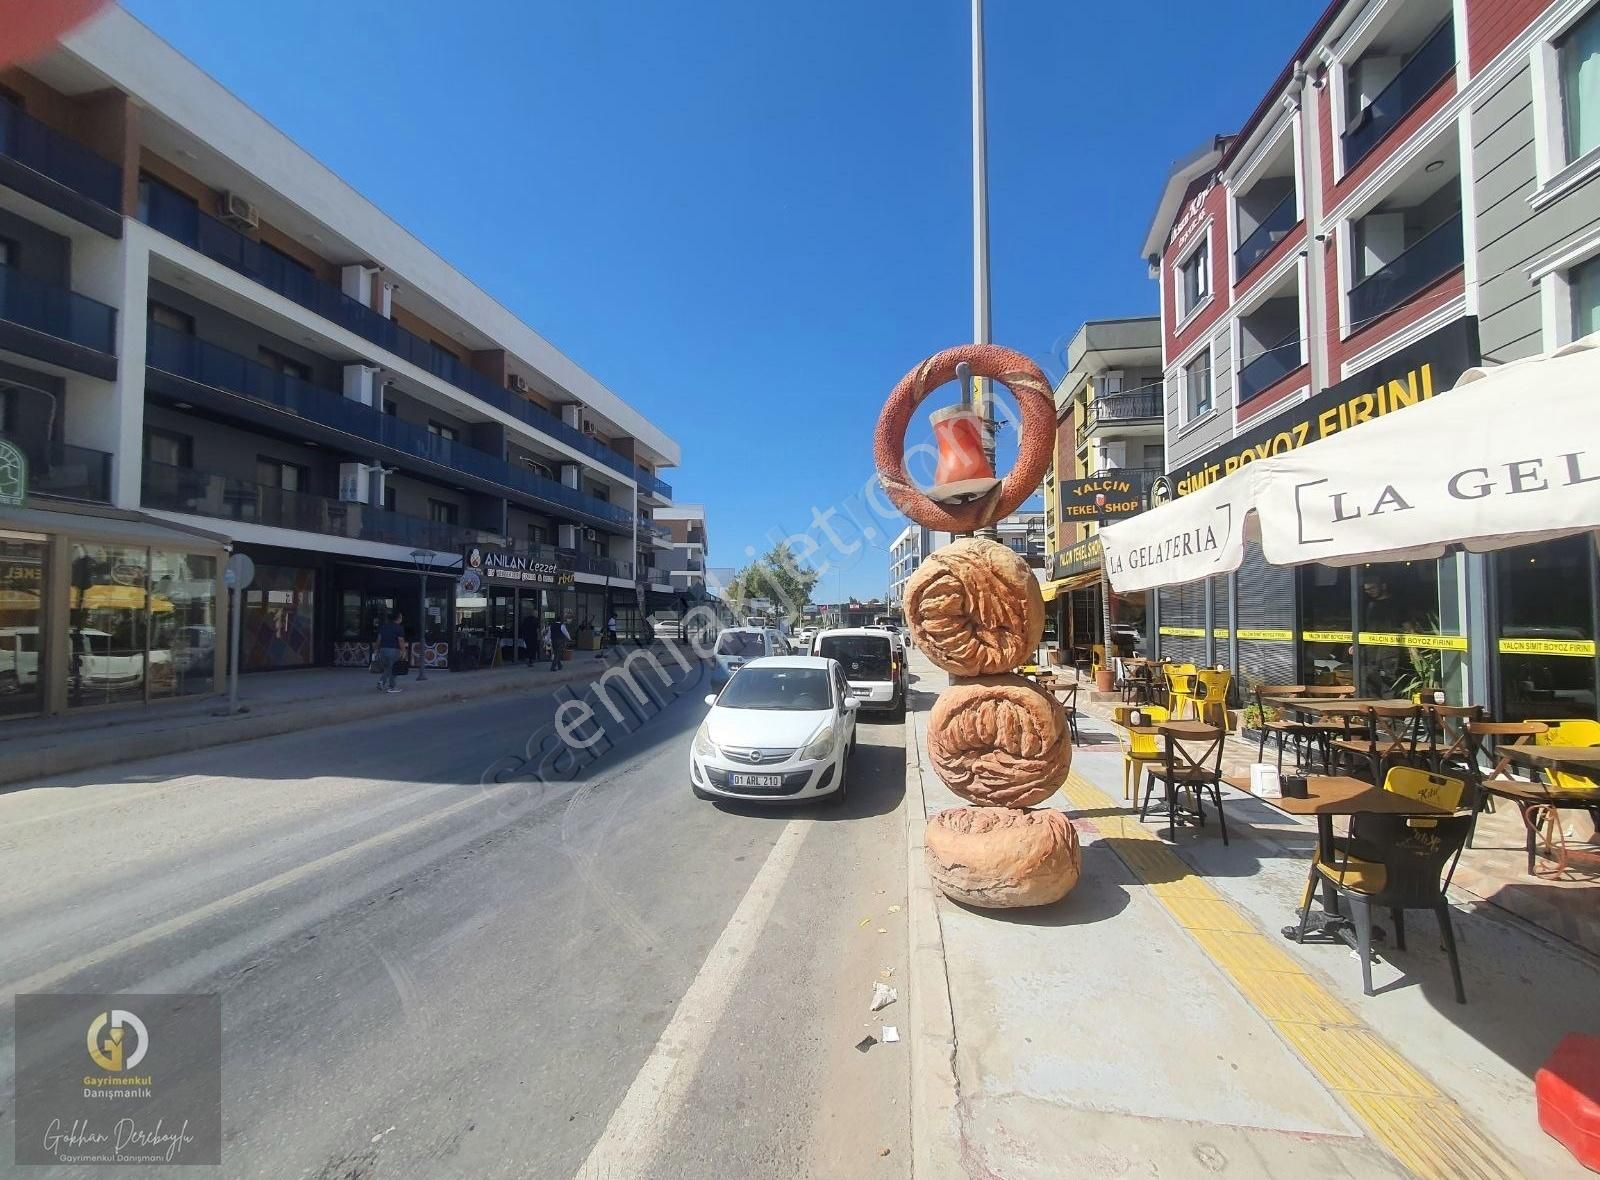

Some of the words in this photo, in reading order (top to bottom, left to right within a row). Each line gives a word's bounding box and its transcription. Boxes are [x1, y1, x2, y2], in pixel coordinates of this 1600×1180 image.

[1318, 363, 1433, 439] FIRINI
[1073, 481, 1130, 496] YALÇIN
[1328, 485, 1416, 523] LA
[1447, 451, 1600, 500] GEL
[1066, 504, 1099, 516] TEKEL
[1105, 501, 1138, 513] SHOP
[1110, 554, 1124, 575] LA
[1128, 524, 1218, 569] GELATERIA
[485, 552, 527, 570] ANILAN
[529, 559, 557, 574] Lezzet
[1368, 635, 1389, 644] YALÇIN
[1407, 637, 1431, 646] BOYOZ
[1432, 638, 1454, 647] FIRINI
[1503, 642, 1525, 650] YALÇIN
[1543, 643, 1569, 651] BOYOZ
[1569, 643, 1592, 652] FIRINI
[734, 775, 743, 785] 01
[746, 775, 761, 786] ARL
[763, 776, 778, 786] 210
